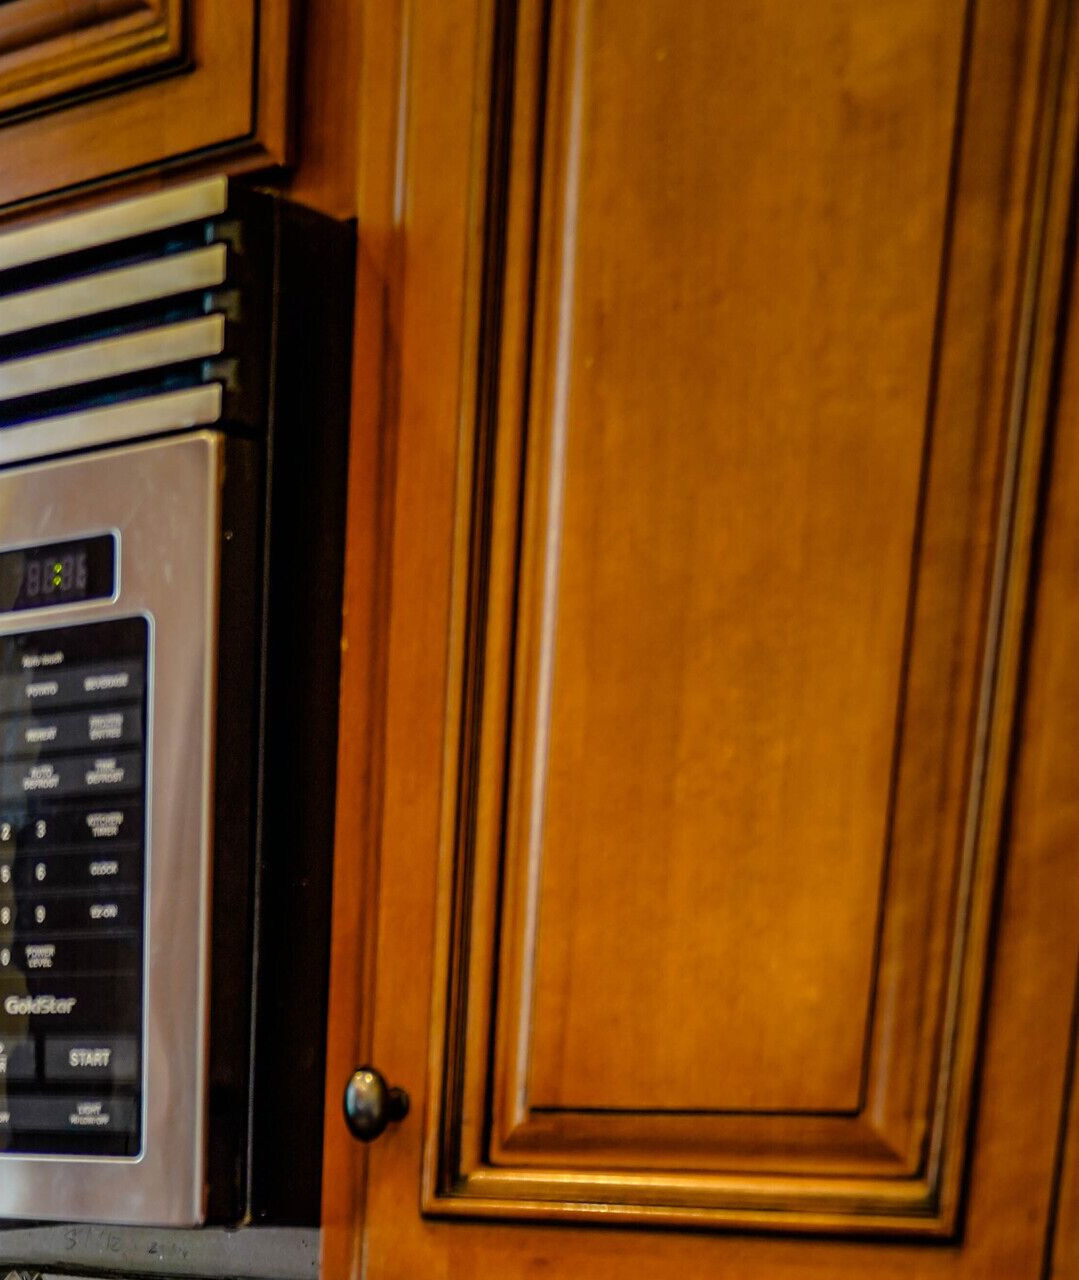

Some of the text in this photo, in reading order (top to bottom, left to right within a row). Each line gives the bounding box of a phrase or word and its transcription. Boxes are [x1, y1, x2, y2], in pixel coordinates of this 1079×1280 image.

[30, 764, 53, 778] AUTO
[23, 775, 60, 791] DEFROST
[1, 823, 11, 841] 2
[36, 820, 46, 838] 3
[1, 865, 11, 883] 5
[35, 863, 46, 881] 6
[90, 862, 118, 876] CLOCK
[1, 907, 11, 924] 8
[35, 905, 46, 923] 9
[27, 959, 53, 969] LEVEL
[4, 995, 77, 1015] GoldStar
[70, 1048, 111, 1067] START
